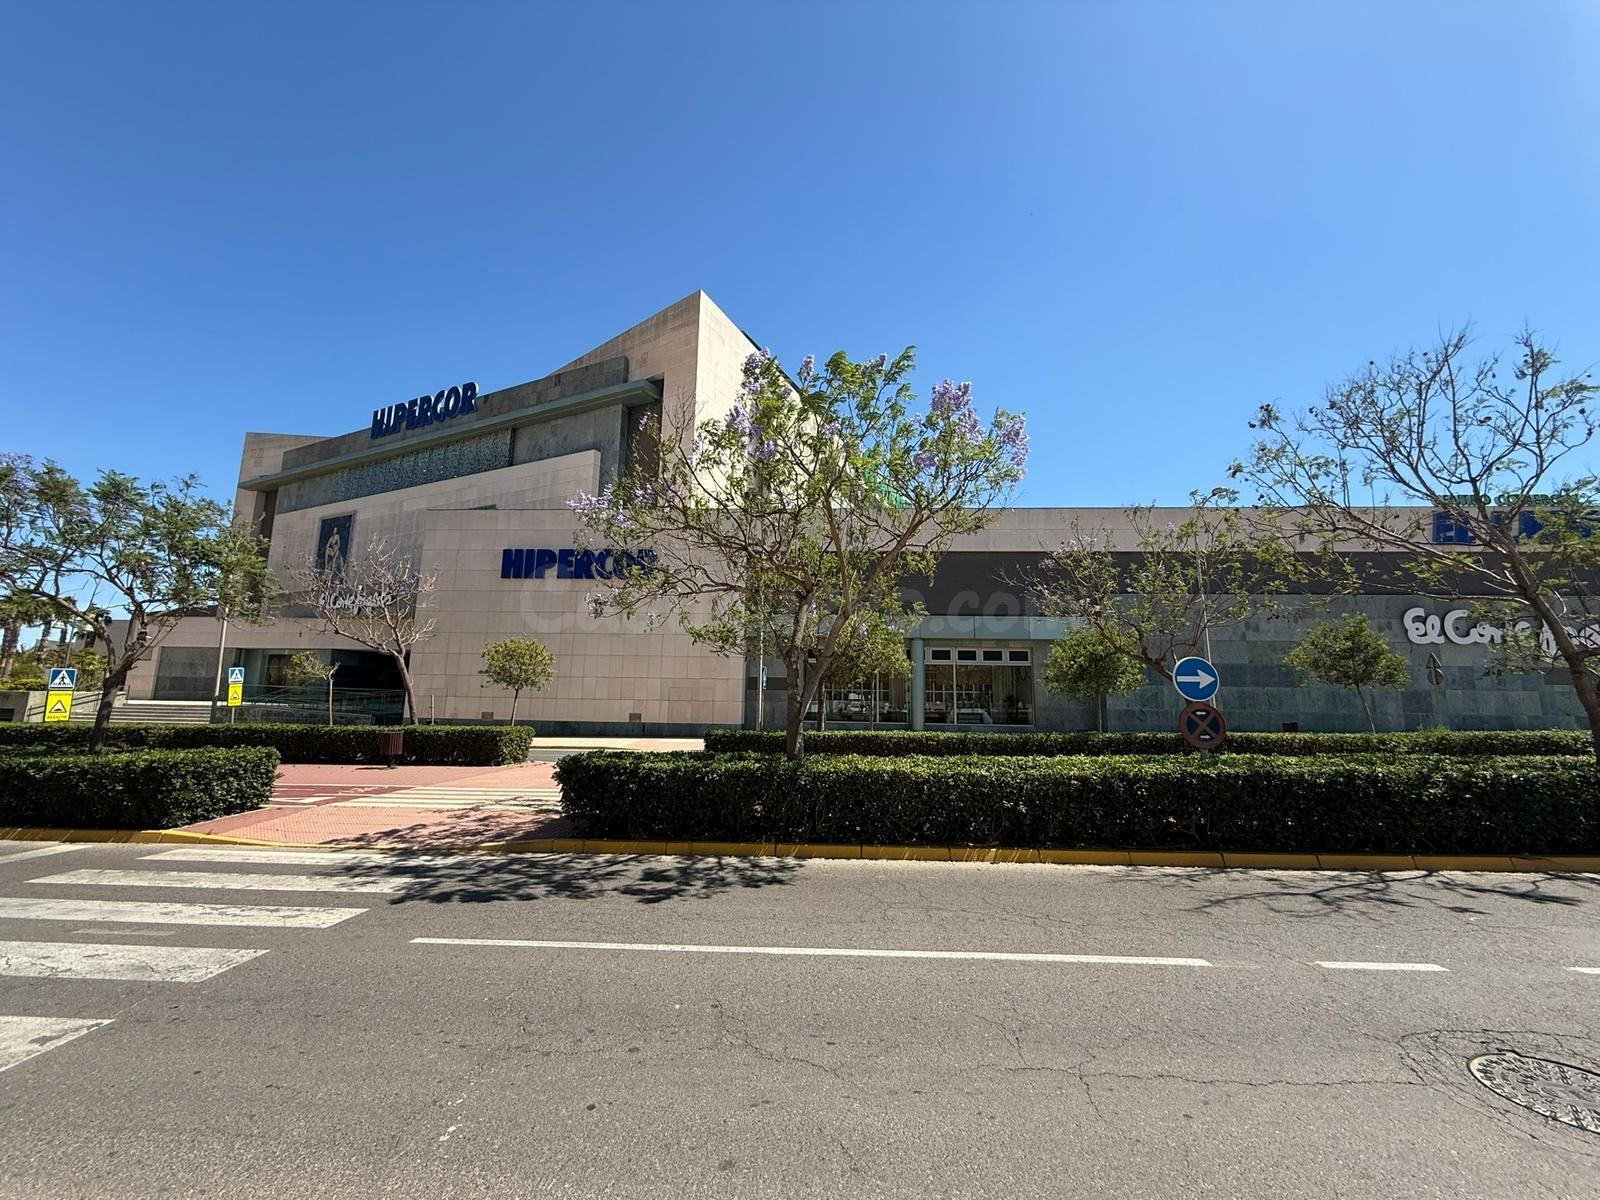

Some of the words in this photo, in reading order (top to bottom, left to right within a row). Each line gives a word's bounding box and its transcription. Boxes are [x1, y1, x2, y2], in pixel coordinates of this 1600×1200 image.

[370, 381, 479, 440] HIPERCOR
[1403, 607, 1445, 645] El
[1443, 609, 1532, 646] Core
